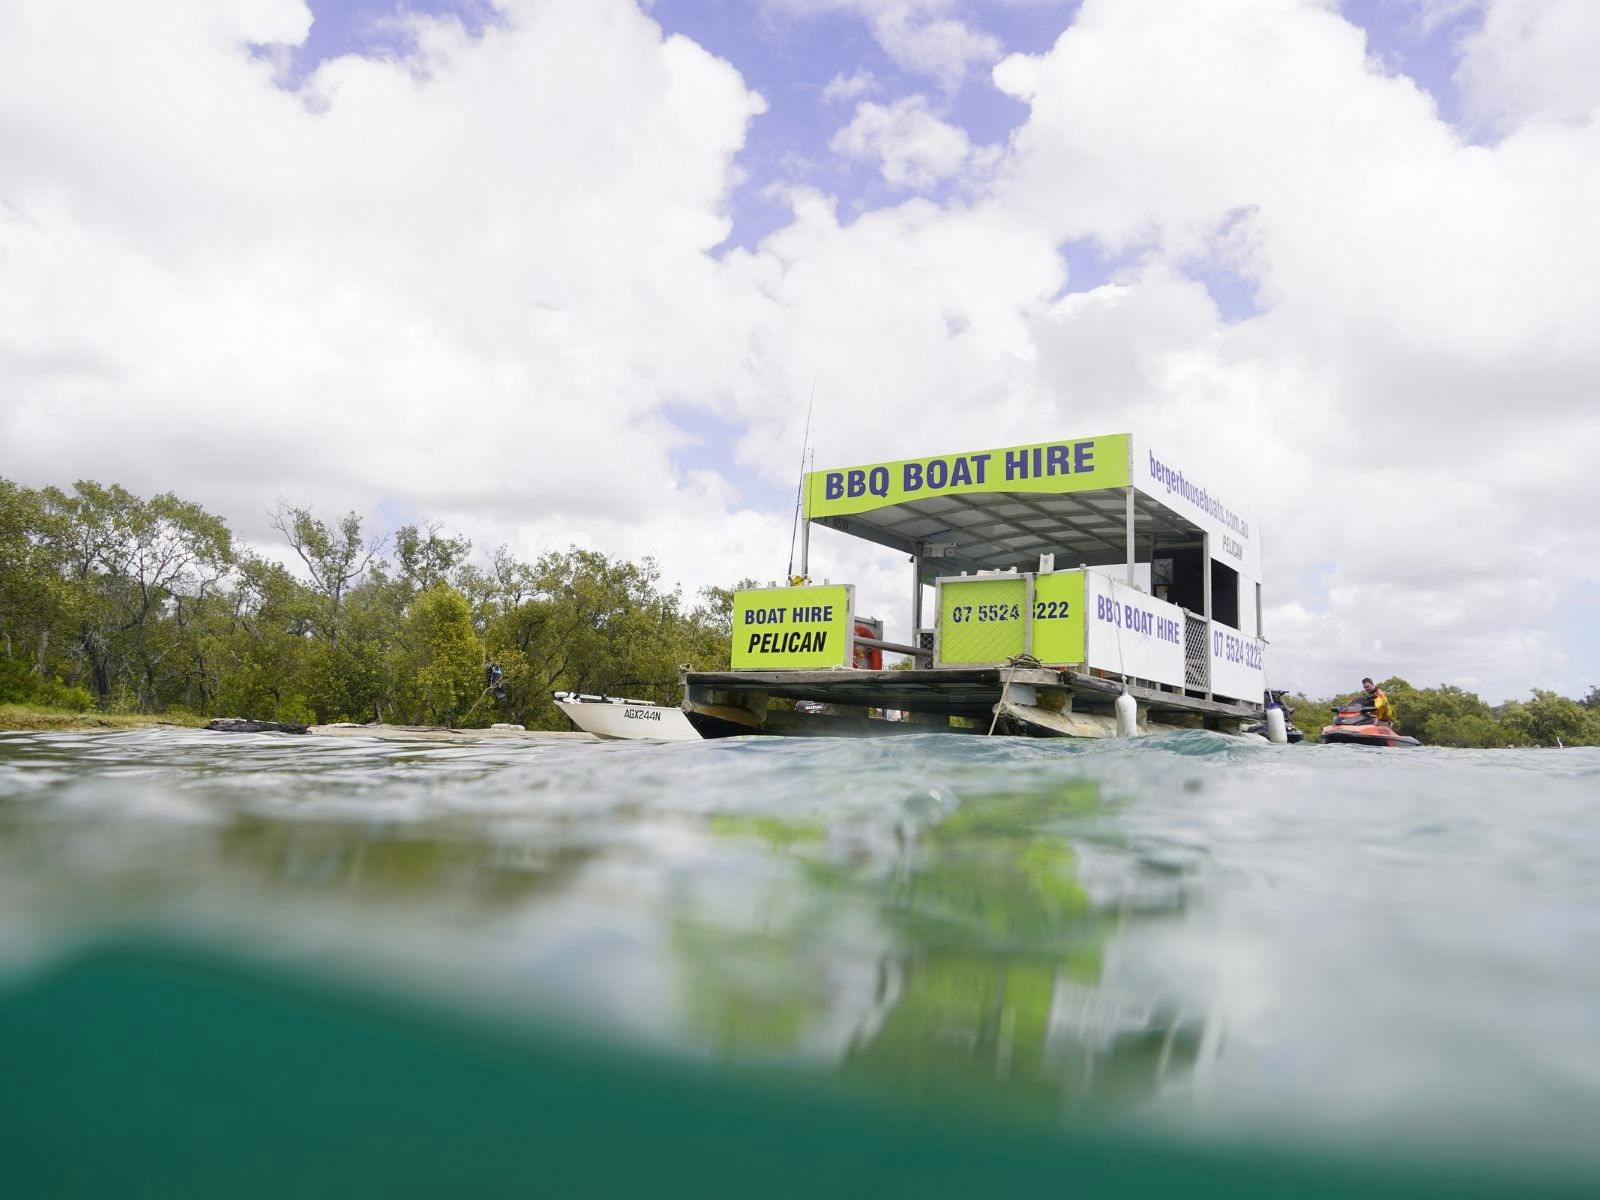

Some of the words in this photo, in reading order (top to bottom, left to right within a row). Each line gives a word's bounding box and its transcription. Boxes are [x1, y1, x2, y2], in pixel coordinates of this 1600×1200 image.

[825, 466, 890, 500] BBQ
[903, 454, 991, 492] BOAT
[1005, 441, 1095, 481] HIRE
[1149, 449, 1249, 540] bergerhouseboats.com.au
[1222, 534, 1243, 561] PELICAN
[745, 607, 787, 625] BOAT
[792, 605, 833, 623] HIRE
[952, 606, 972, 623] 07
[978, 603, 1020, 622] 5524
[1097, 594, 1121, 629] BBQ
[1124, 604, 1154, 636] BOAT
[1157, 616, 1180, 645] HIRE
[747, 631, 828, 654] PELICAN
[1213, 630, 1224, 658] 07
[1226, 634, 1244, 664] 5524
[1245, 643, 1262, 671] 3222
